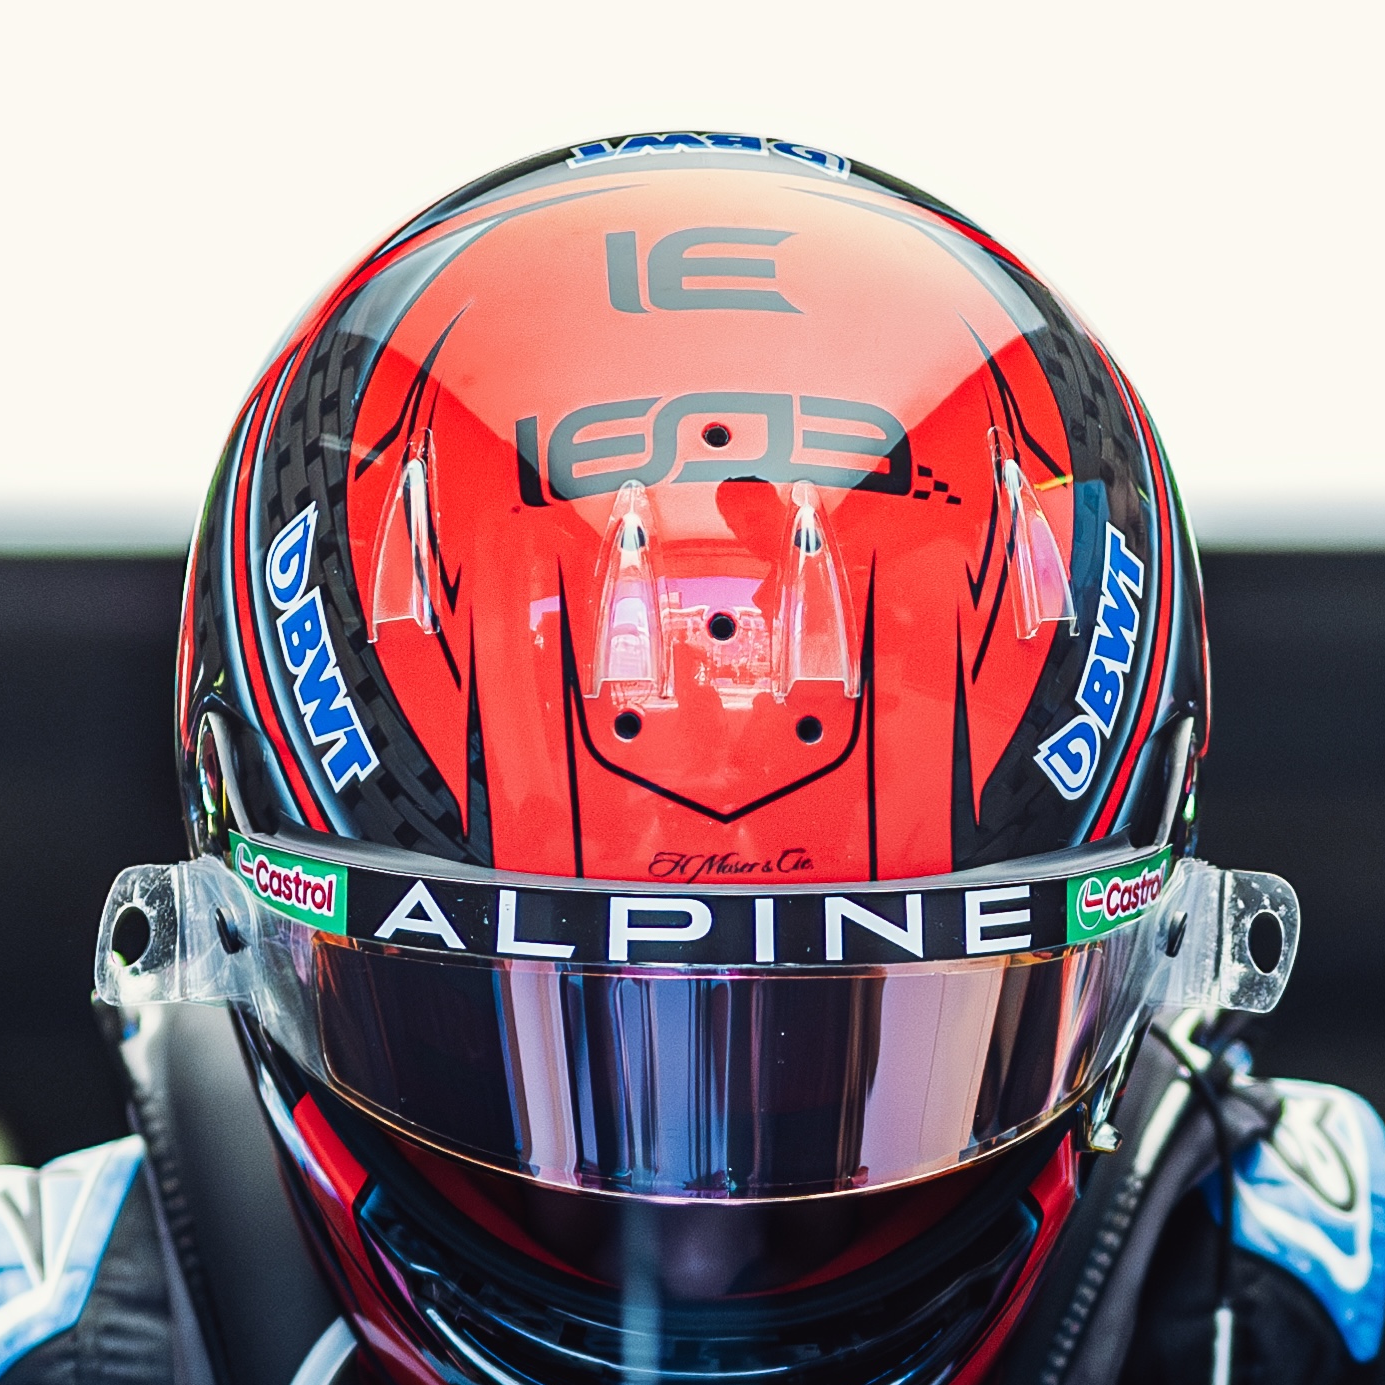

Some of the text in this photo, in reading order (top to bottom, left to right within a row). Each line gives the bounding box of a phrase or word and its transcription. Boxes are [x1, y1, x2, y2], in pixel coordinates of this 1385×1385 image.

[566, 132, 769, 169] BWT
[1075, 521, 1144, 739] BWT
[276, 586, 380, 793] BWT
[255, 856, 336, 916] Castrol
[373, 878, 1033, 963] ALPINE
